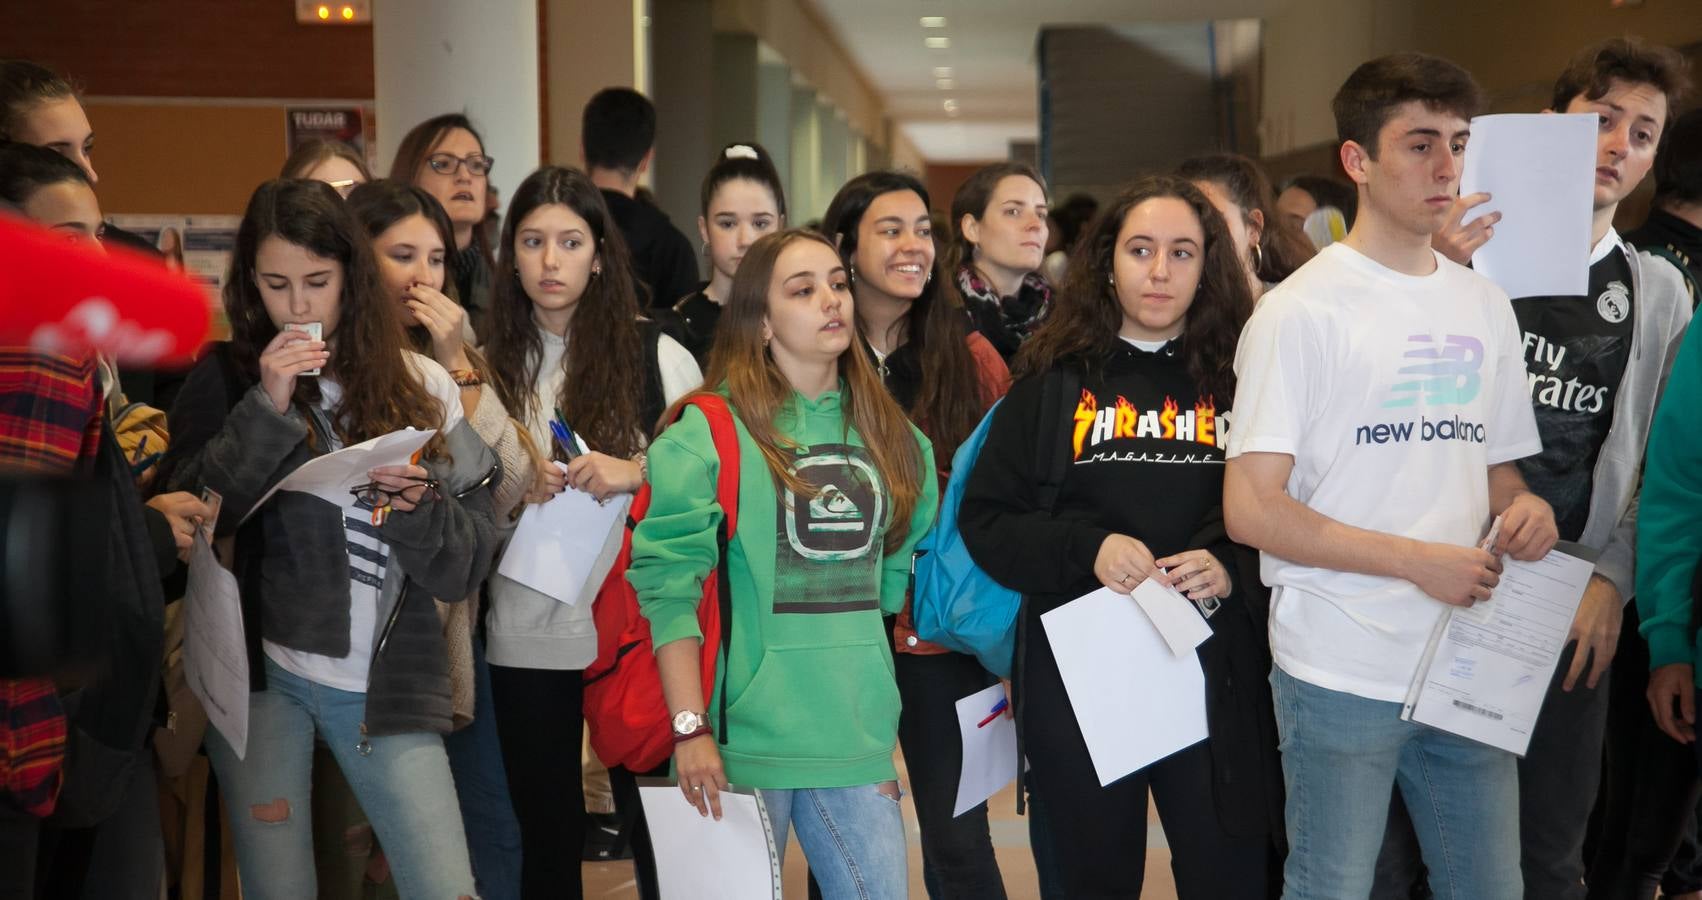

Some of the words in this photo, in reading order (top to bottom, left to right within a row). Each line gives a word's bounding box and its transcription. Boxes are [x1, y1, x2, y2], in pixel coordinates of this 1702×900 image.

[1520, 331, 1566, 371] Fly
[1527, 372, 1608, 413] rates
[1356, 421, 1415, 445] new
[1091, 452, 1213, 464] MAGAZINE
